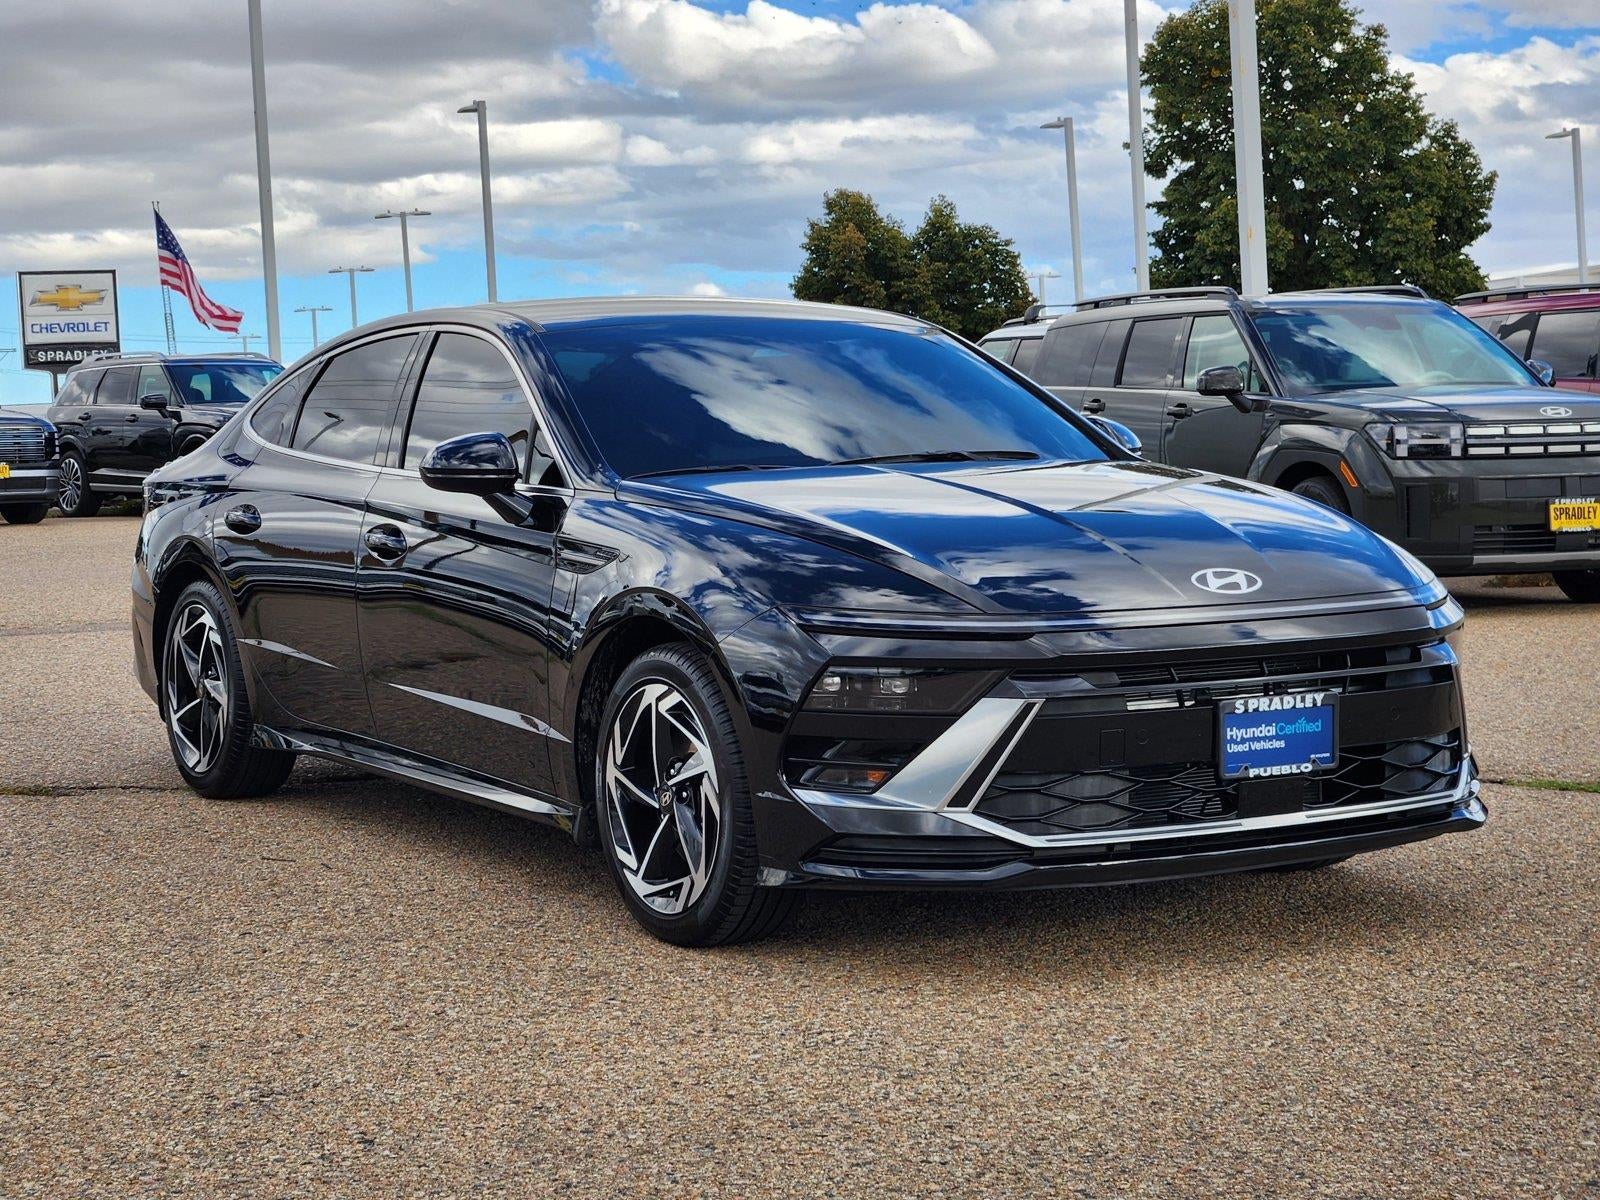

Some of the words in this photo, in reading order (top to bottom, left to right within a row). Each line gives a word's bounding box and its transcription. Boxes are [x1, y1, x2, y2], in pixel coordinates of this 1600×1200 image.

[31, 321, 110, 334] CHEVROLET
[1553, 506, 1598, 520] SPRADLEY
[1234, 693, 1325, 713] SPRADLEY
[1226, 723, 1276, 741] Hyundai
[1276, 717, 1322, 735] Certified
[1226, 742, 1249, 753] Used
[1249, 739, 1286, 751] Vehicles
[1248, 763, 1313, 778] PUEBLO
